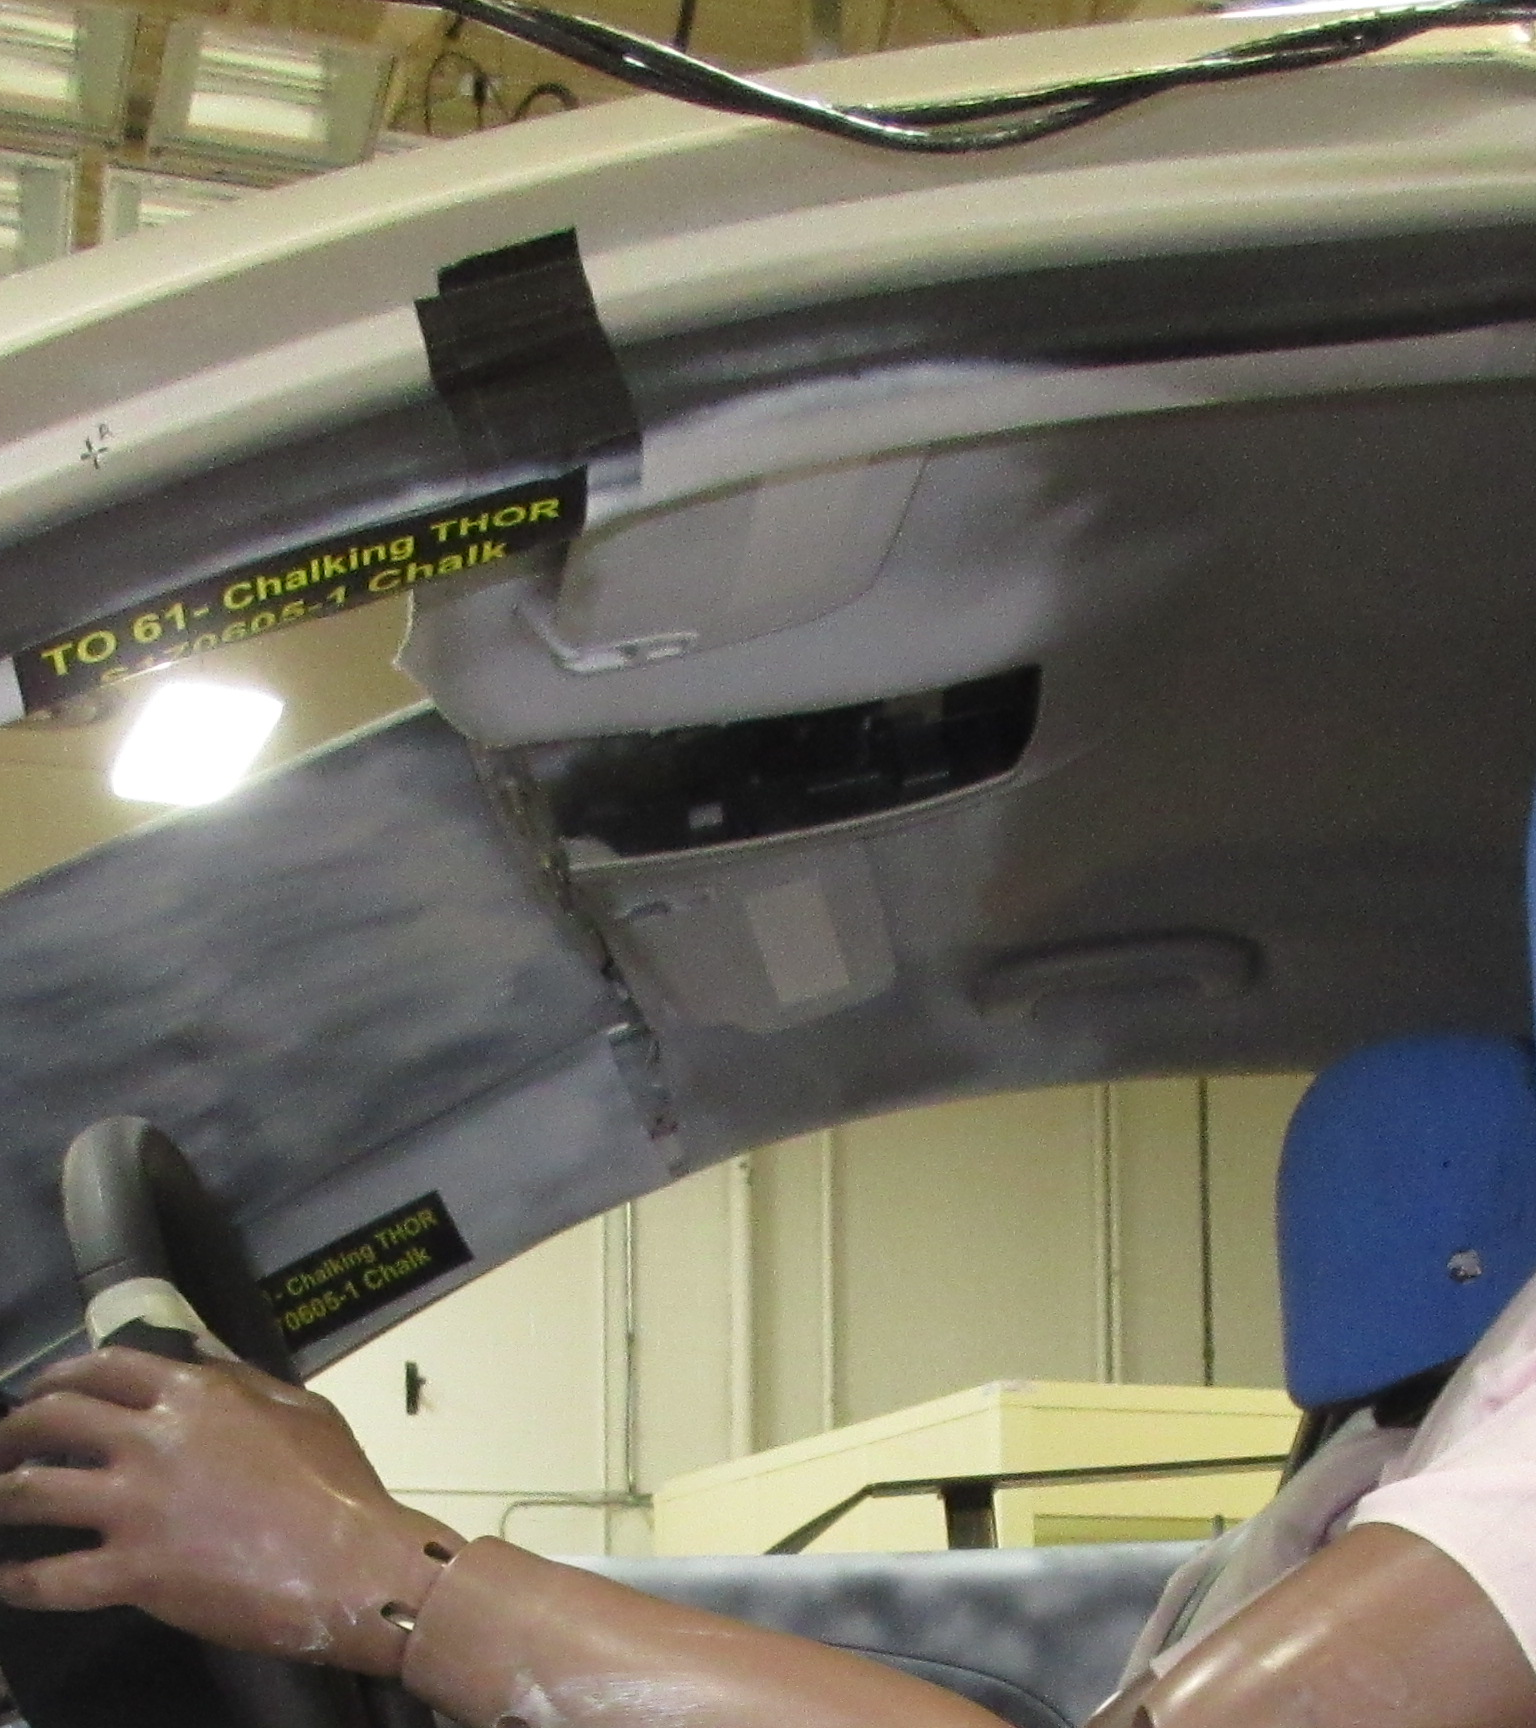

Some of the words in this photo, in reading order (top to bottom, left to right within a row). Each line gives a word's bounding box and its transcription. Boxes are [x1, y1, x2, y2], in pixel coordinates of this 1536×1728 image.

[41, 630, 116, 676] TO
[133, 602, 210, 643] 61-
[223, 535, 414, 610] Chalking
[430, 498, 560, 541] THOR
[368, 540, 507, 592] Chalk
[278, 1281, 361, 1331] 0605-1
[363, 1246, 432, 1291] Chalk
[286, 1244, 376, 1296] Chalking
[373, 1208, 438, 1249] THOR
